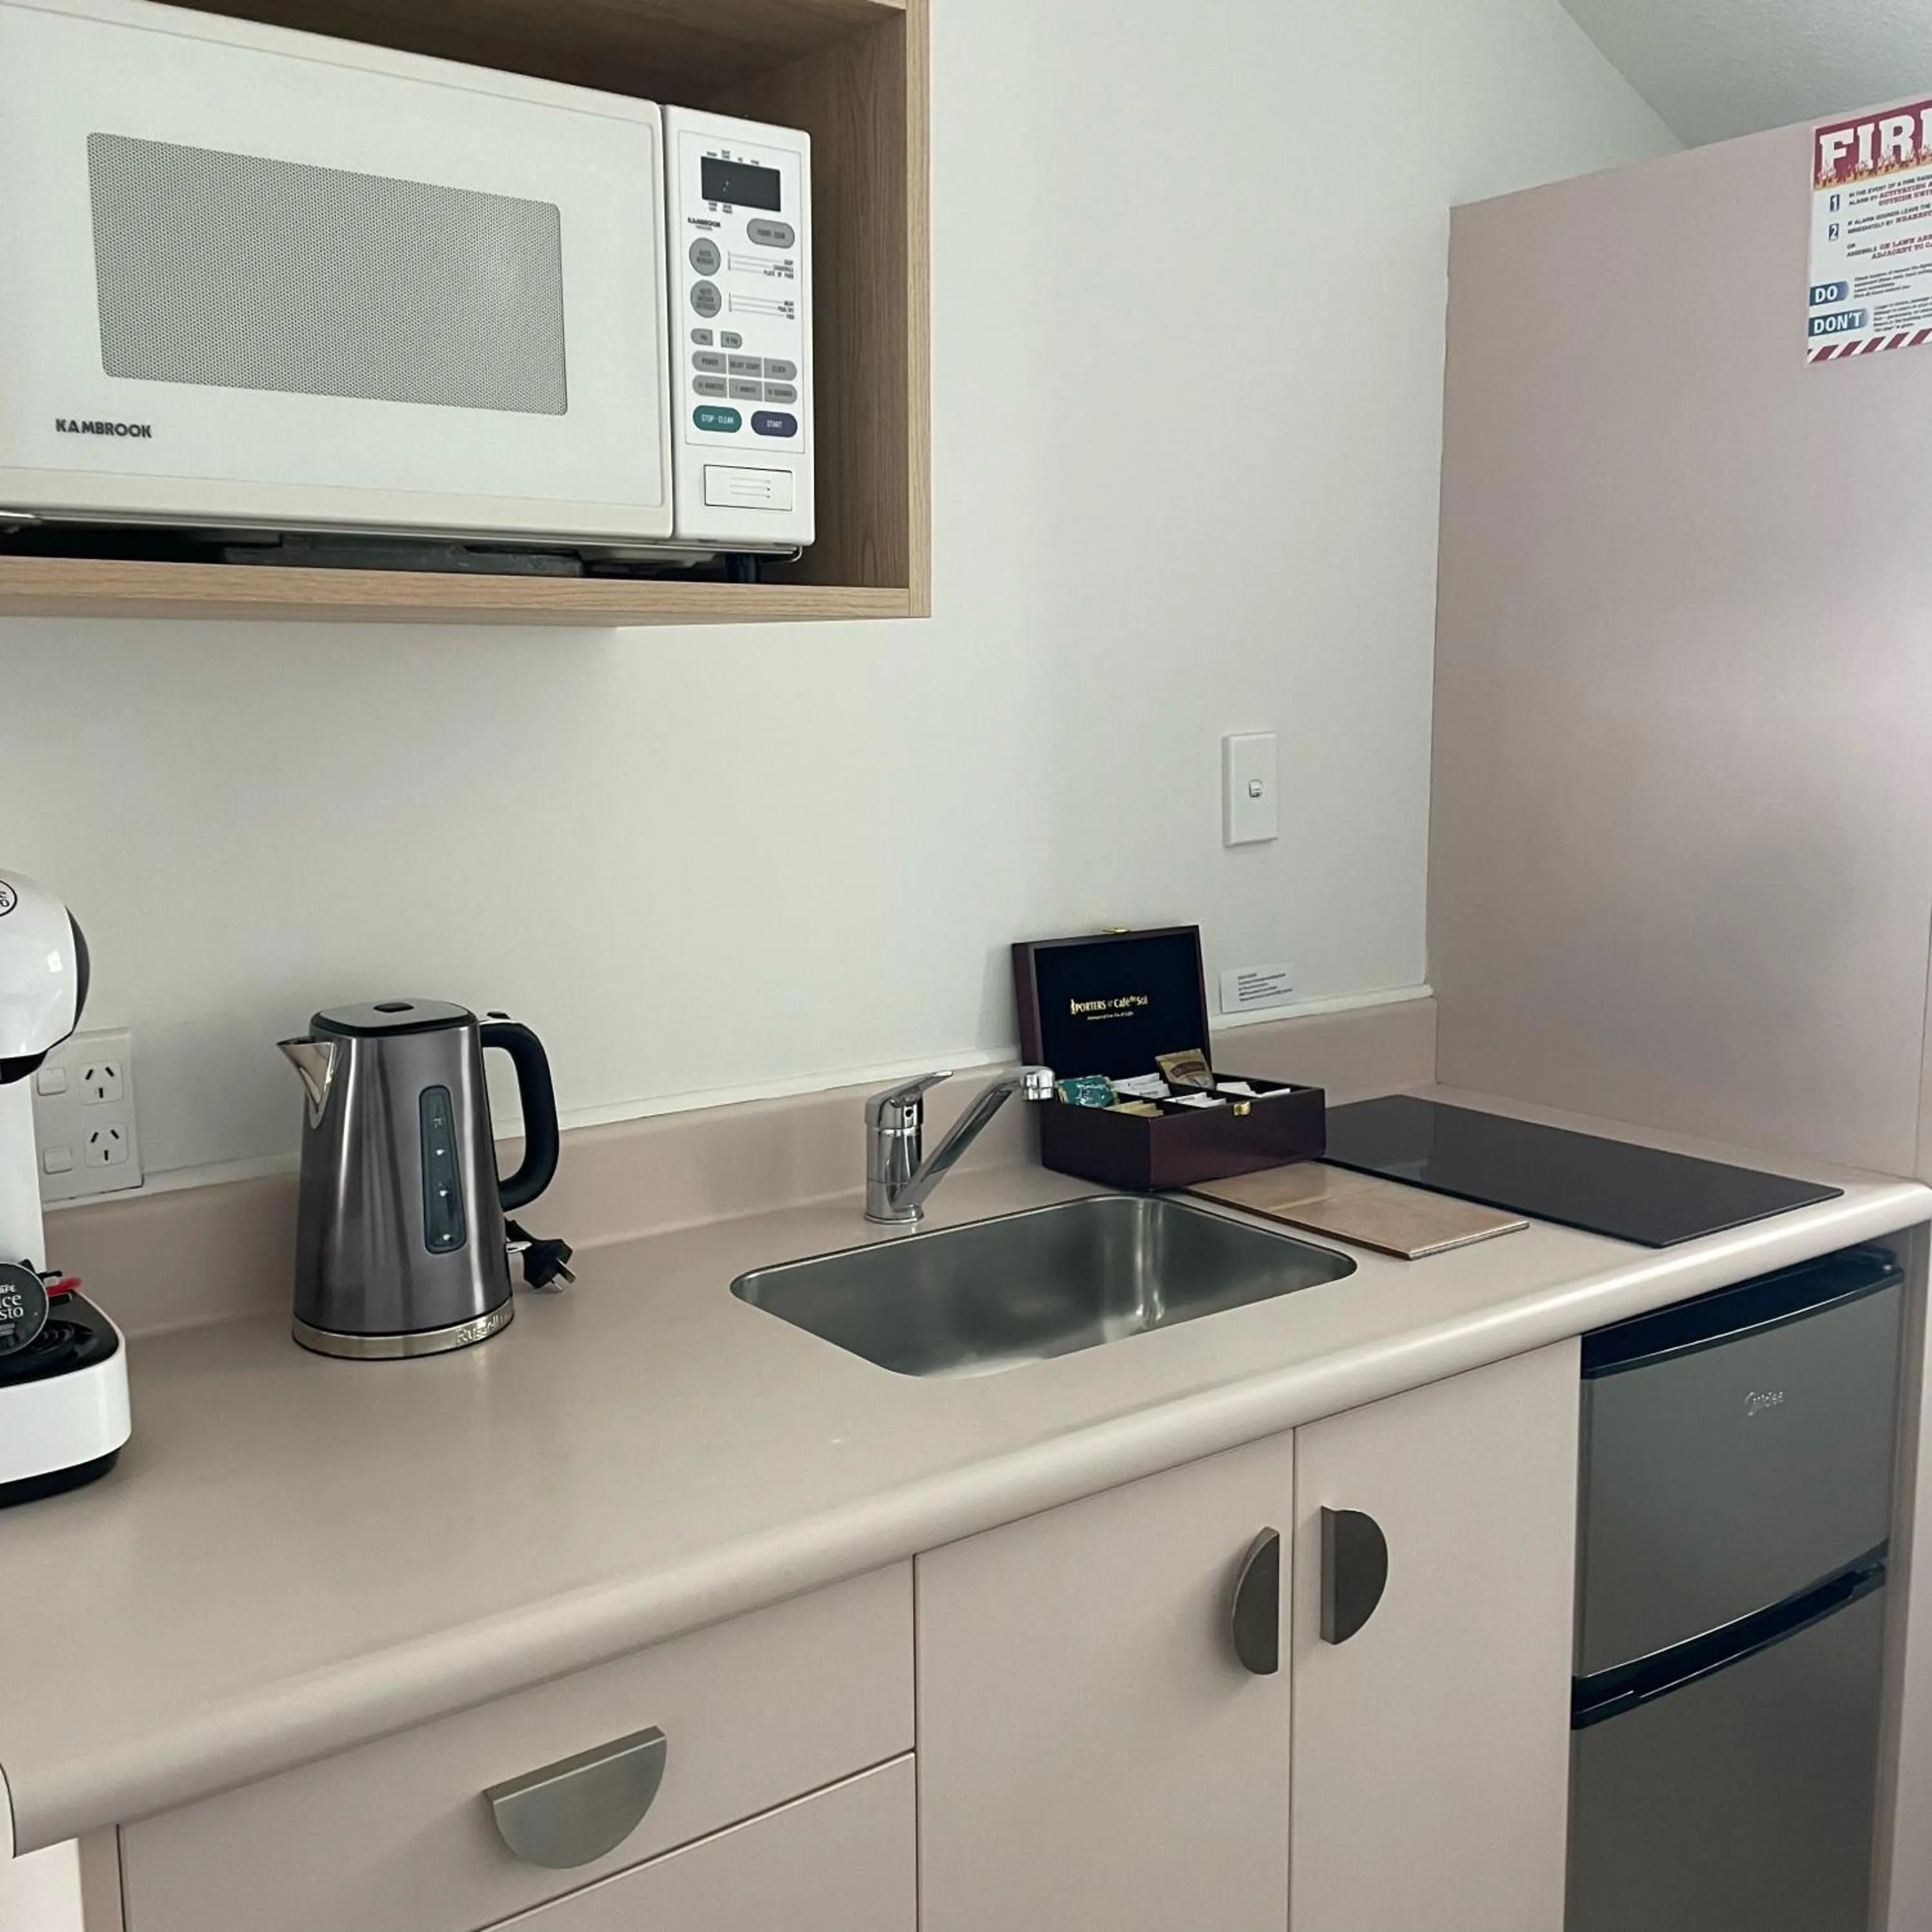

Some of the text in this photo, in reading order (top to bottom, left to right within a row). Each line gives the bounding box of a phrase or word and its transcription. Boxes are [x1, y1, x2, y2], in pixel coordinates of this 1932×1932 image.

[1815, 285, 1838, 303] DO
[1814, 311, 1862, 334] DON'T
[55, 418, 152, 438] KAMBROOK
